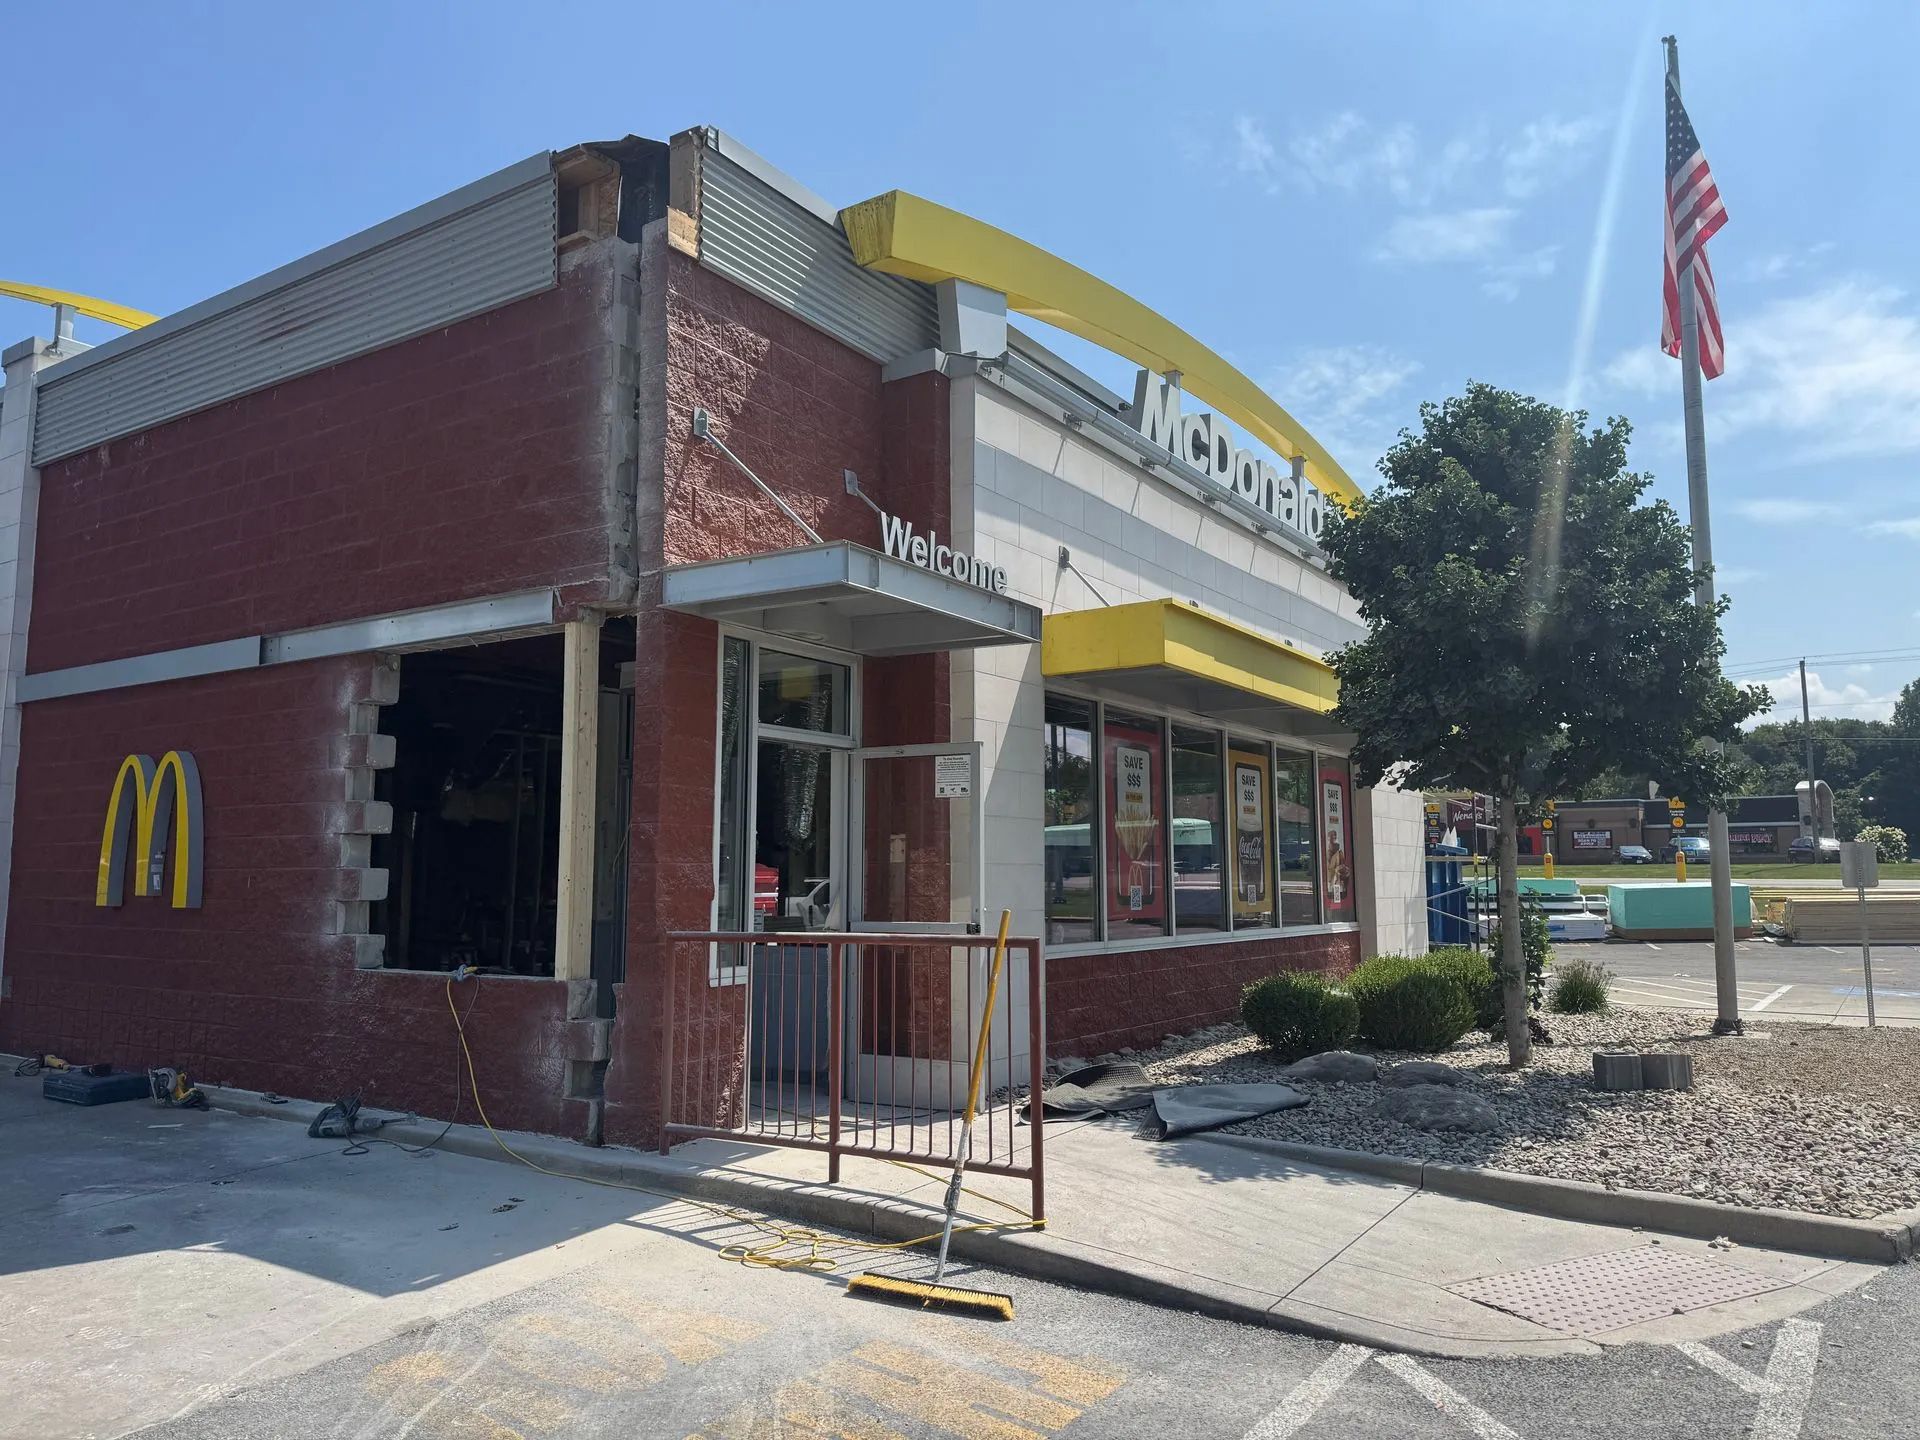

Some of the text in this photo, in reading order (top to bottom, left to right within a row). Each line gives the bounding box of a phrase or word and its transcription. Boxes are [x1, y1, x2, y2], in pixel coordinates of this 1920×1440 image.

[1135, 369, 1332, 542] McDonald
[880, 510, 1008, 595] Welcome
[1124, 755, 1143, 769] SAVE
[1127, 773, 1141, 788] $$$
[1242, 774, 1256, 787] SAVE
[1244, 789, 1255, 802] $$$
[1328, 789, 1338, 800] SAVE
